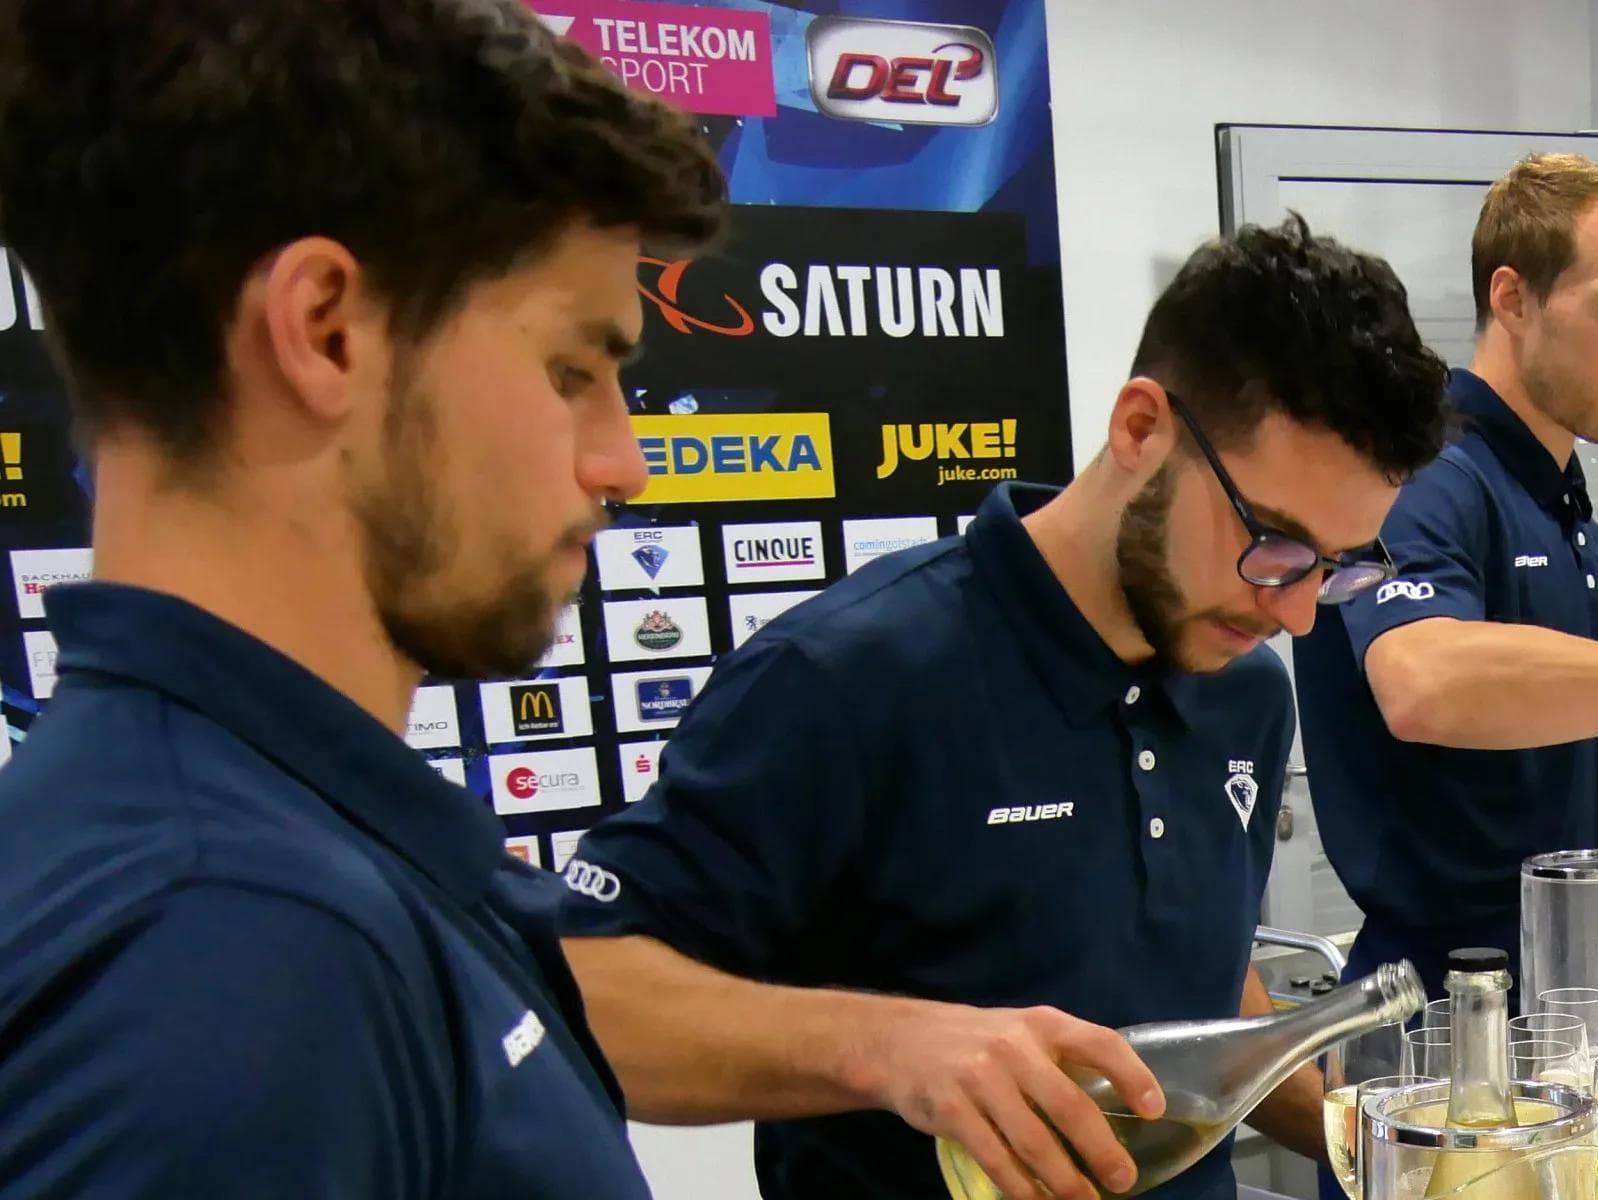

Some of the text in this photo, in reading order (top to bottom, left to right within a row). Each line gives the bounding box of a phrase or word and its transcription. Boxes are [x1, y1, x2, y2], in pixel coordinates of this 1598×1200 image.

[592, 17, 757, 62] TELEKOM
[760, 263, 1005, 338] SATURN
[637, 434, 822, 475] EDEKA
[877, 419, 1017, 479] JUKE!
[937, 465, 1017, 486] juke.com
[634, 531, 663, 540] ERC
[734, 537, 814, 561] CINQUE
[21, 573, 91, 582] BACKHAU
[407, 721, 448, 732] TIMO
[1228, 760, 1254, 774] ERC
[516, 771, 579, 791] secura
